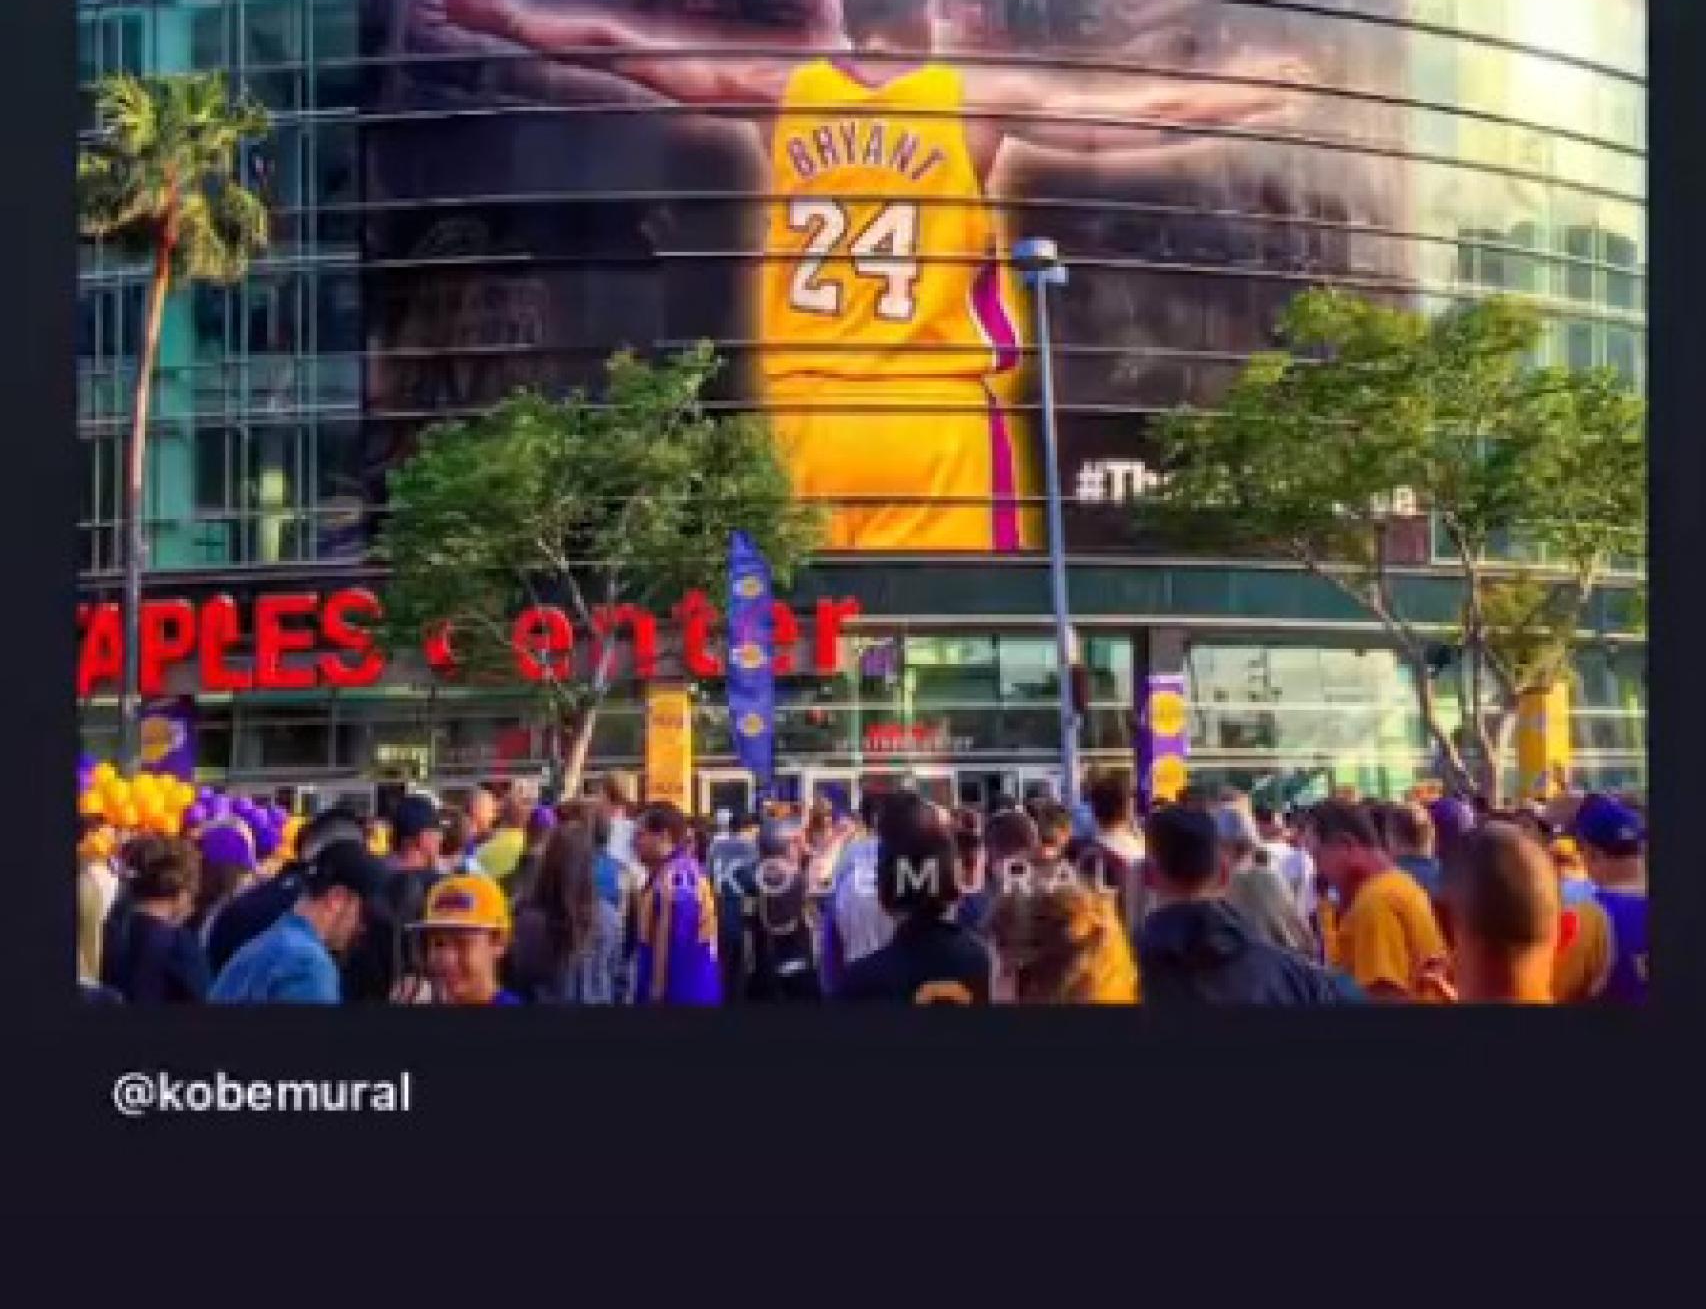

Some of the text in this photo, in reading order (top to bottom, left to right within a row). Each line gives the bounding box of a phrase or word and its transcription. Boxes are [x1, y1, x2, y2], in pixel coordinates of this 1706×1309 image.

[787, 119, 946, 181] BRYANT
[787, 196, 918, 321] 24
[77, 588, 386, 697] APLES
